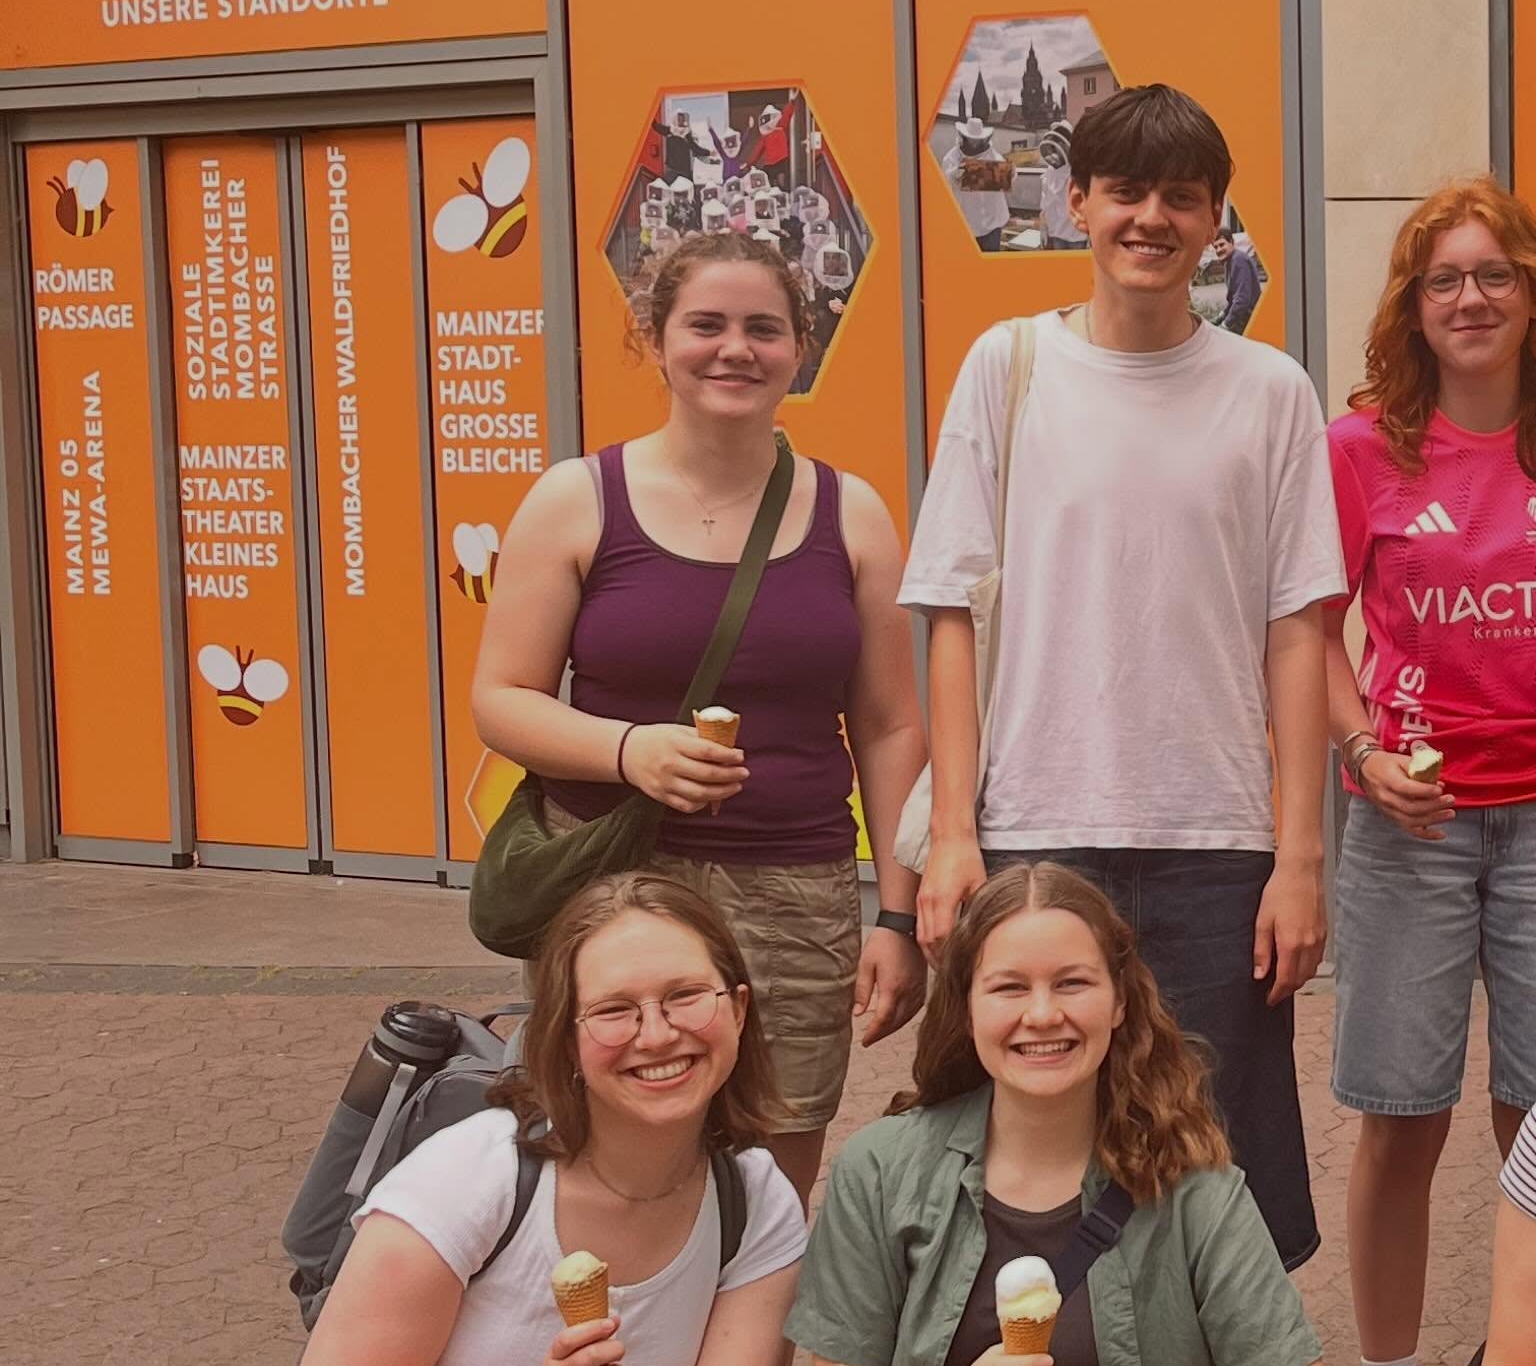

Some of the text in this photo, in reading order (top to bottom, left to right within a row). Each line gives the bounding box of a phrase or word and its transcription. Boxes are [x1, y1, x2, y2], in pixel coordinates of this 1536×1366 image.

[35, 262, 115, 294] RÖMER
[201, 159, 231, 400] STADTIMKEREI
[227, 178, 254, 399] MOMBACHER
[37, 303, 135, 330] PASSAGE
[255, 255, 279, 400] STRASSE
[182, 263, 207, 400] SOZIALE
[327, 147, 366, 597] MOMBACHER WALDFRIEDHOF
[437, 344, 522, 372] STADT-
[438, 378, 507, 406] HAUS
[440, 412, 538, 440] GROSSE
[180, 445, 287, 470] MAINZER
[441, 447, 544, 474] BLEICHE
[82, 370, 112, 595] MEWA-ARENA
[180, 477, 274, 503] STAATS-
[60, 438, 85, 595] MAINZ 05
[182, 509, 285, 535] THEATER
[184, 541, 279, 568] KLEINES
[185, 573, 249, 599] HAUS
